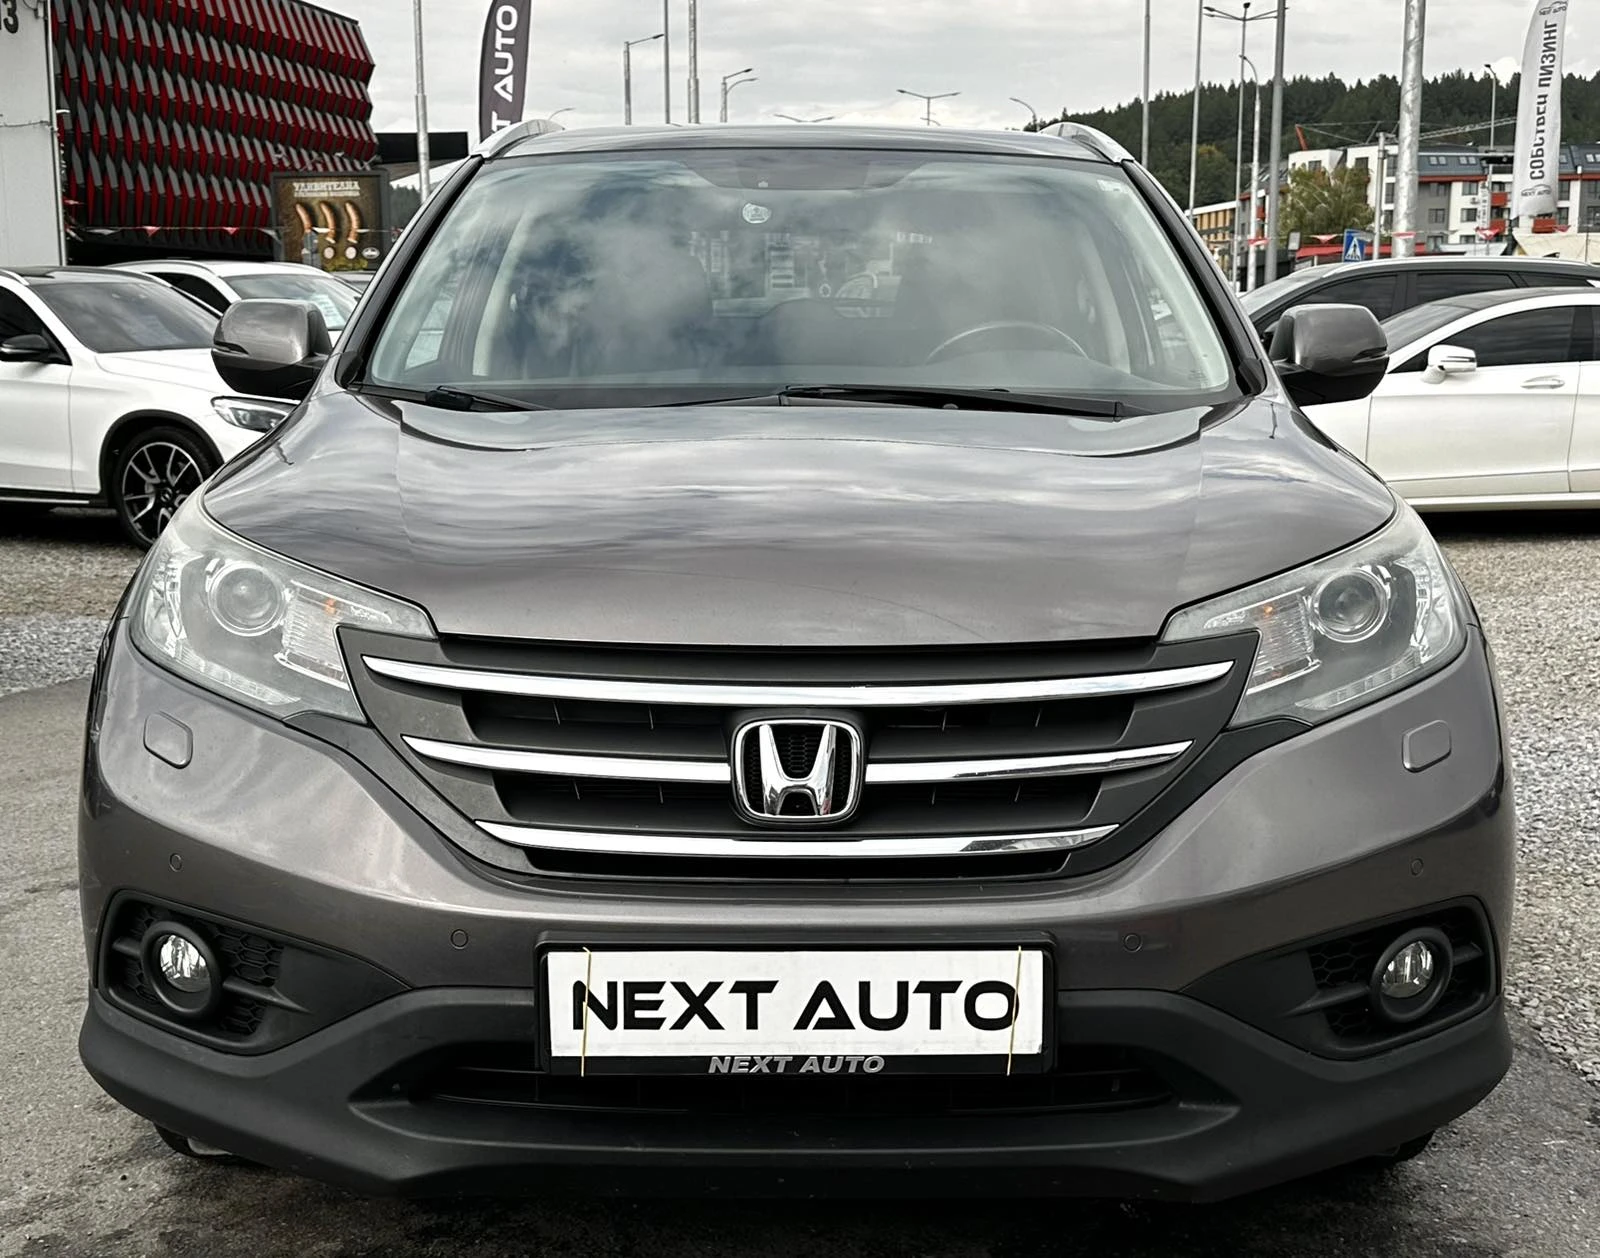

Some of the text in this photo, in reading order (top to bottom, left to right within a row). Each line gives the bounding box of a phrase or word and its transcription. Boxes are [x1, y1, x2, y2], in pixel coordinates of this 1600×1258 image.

[494, 5, 518, 102] AUTO
[573, 979, 1020, 1031] NEXT AUTO
[708, 1056, 885, 1074] NEXT AUTO
